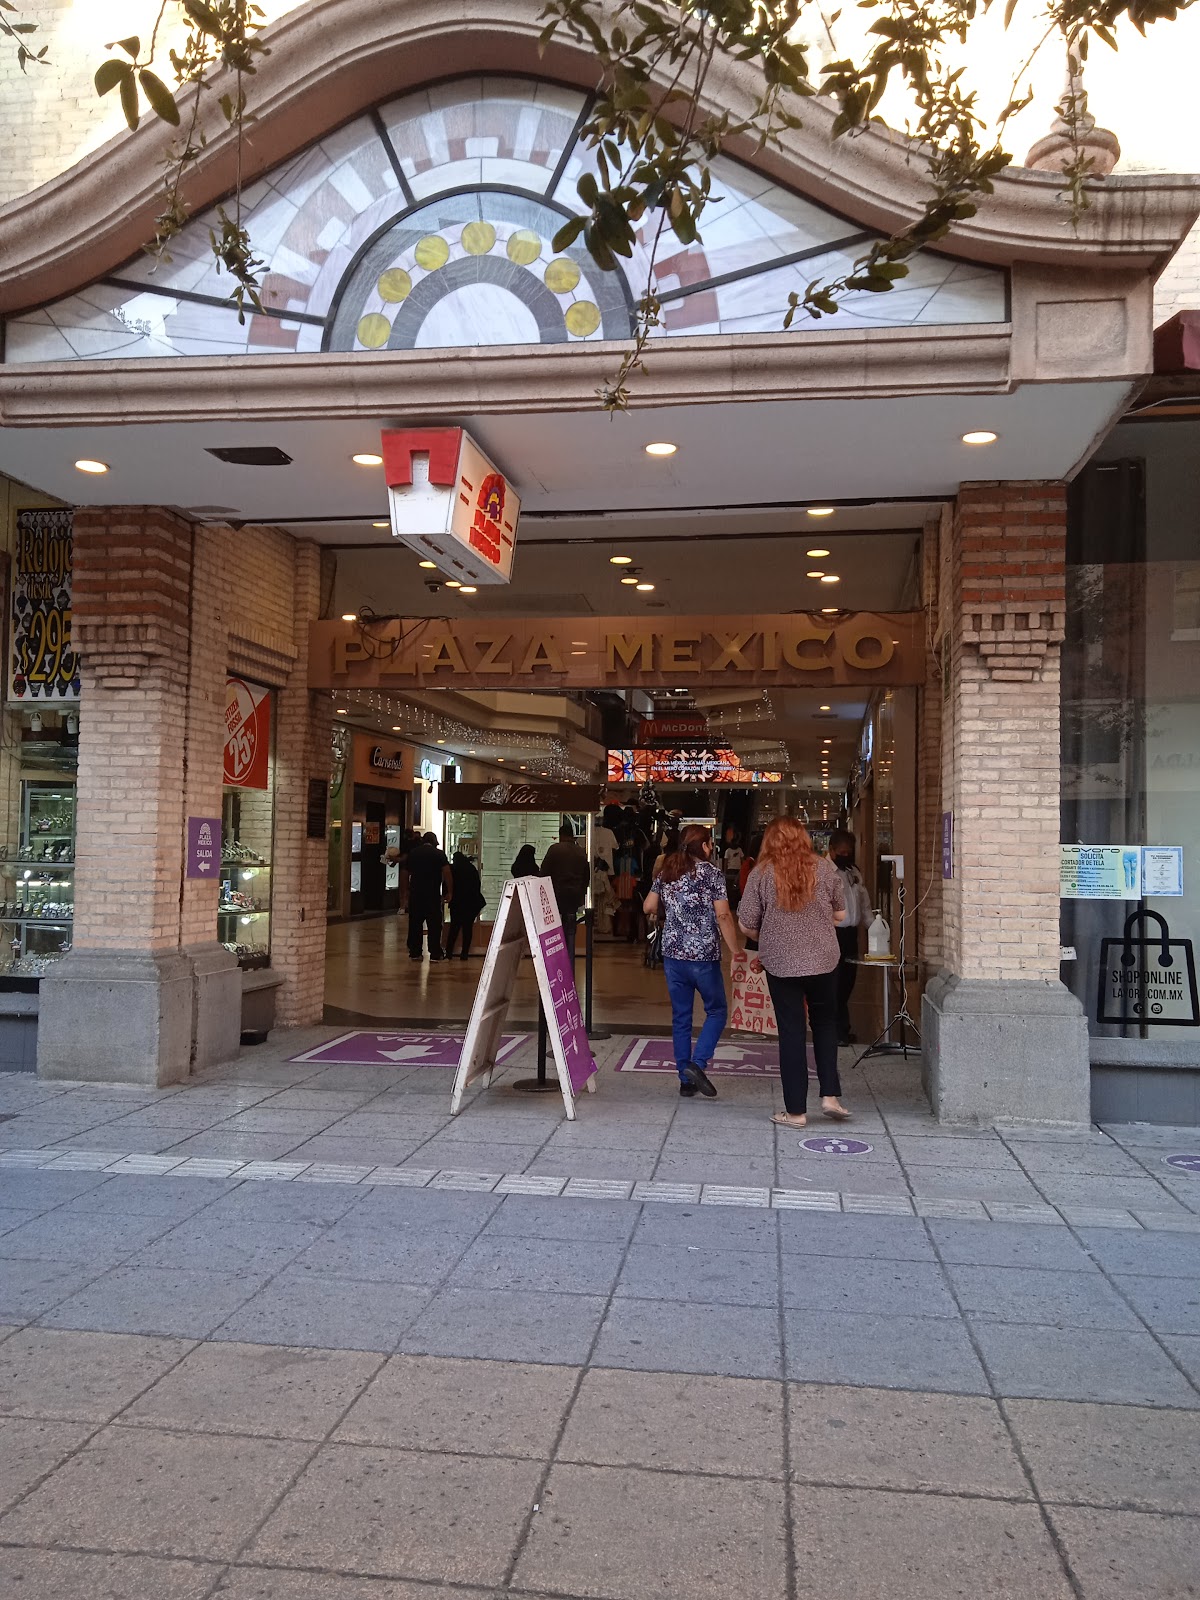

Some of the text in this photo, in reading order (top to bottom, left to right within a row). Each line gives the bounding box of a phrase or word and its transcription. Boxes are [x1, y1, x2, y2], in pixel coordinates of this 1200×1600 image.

[333, 629, 895, 675] PLAZA MEXICO
[228, 726, 255, 777] 25%
[196, 849, 213, 858] SALIDA
[1111, 970, 1183, 985] SHOP ONLINE
